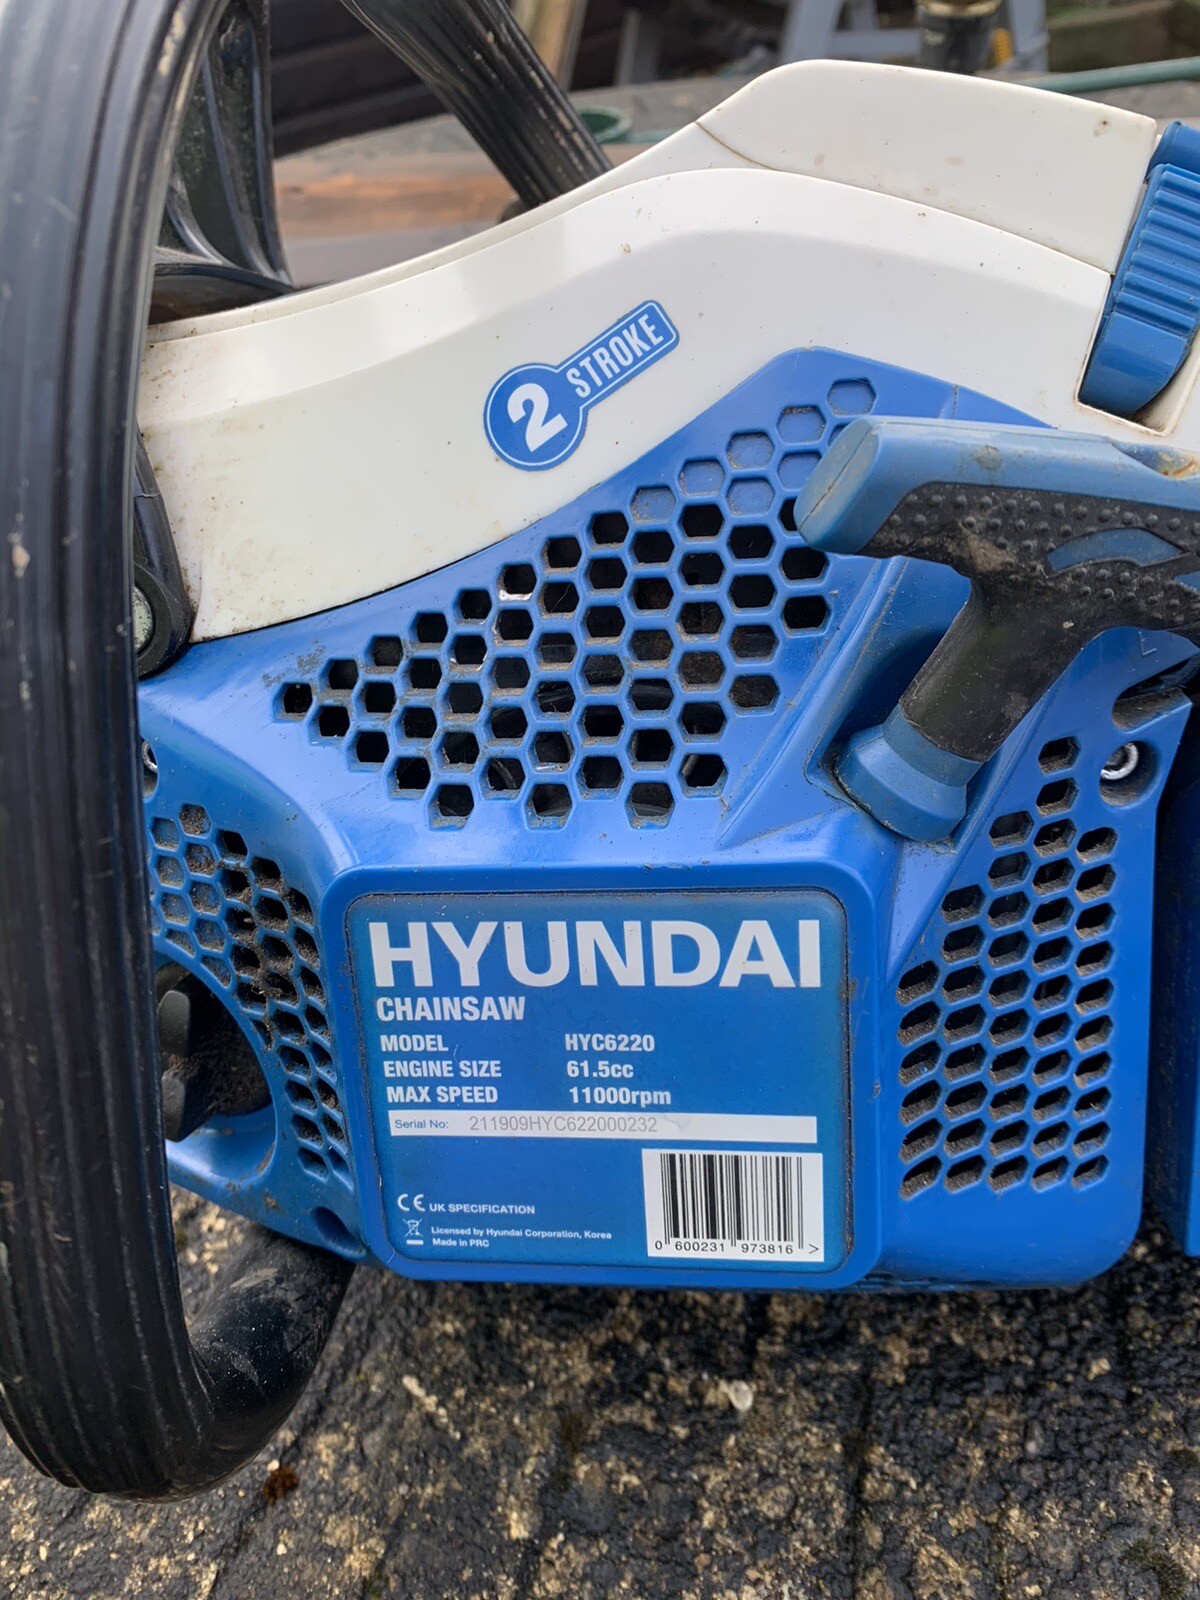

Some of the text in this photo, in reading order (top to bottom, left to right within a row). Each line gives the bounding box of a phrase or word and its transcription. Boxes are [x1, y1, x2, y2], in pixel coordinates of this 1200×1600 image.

[507, 313, 664, 453] 2 STROKE
[368, 919, 822, 988] HYUNDAI
[376, 996, 525, 1021] CHAINSAW
[380, 1033, 655, 1052] MODEL HYC6220
[383, 1060, 634, 1078] ENGINE SIZE 61.5cc
[386, 1086, 672, 1108] MAX SPEED 11000rpm
[394, 1115, 658, 1133] Serial No: 211909HYC622000232
[429, 1203, 536, 1215] UK SPECIFICATION
[431, 1226, 471, 1236] Licensed
[473, 1227, 484, 1237] by
[486, 1228, 523, 1238] Hyundai
[525, 1229, 582, 1240] Corporation,
[432, 1238, 490, 1248] Made in PRC
[655, 1240, 663, 1251] 0
[675, 1241, 726, 1253] 600231
[741, 1243, 794, 1255] 973816
